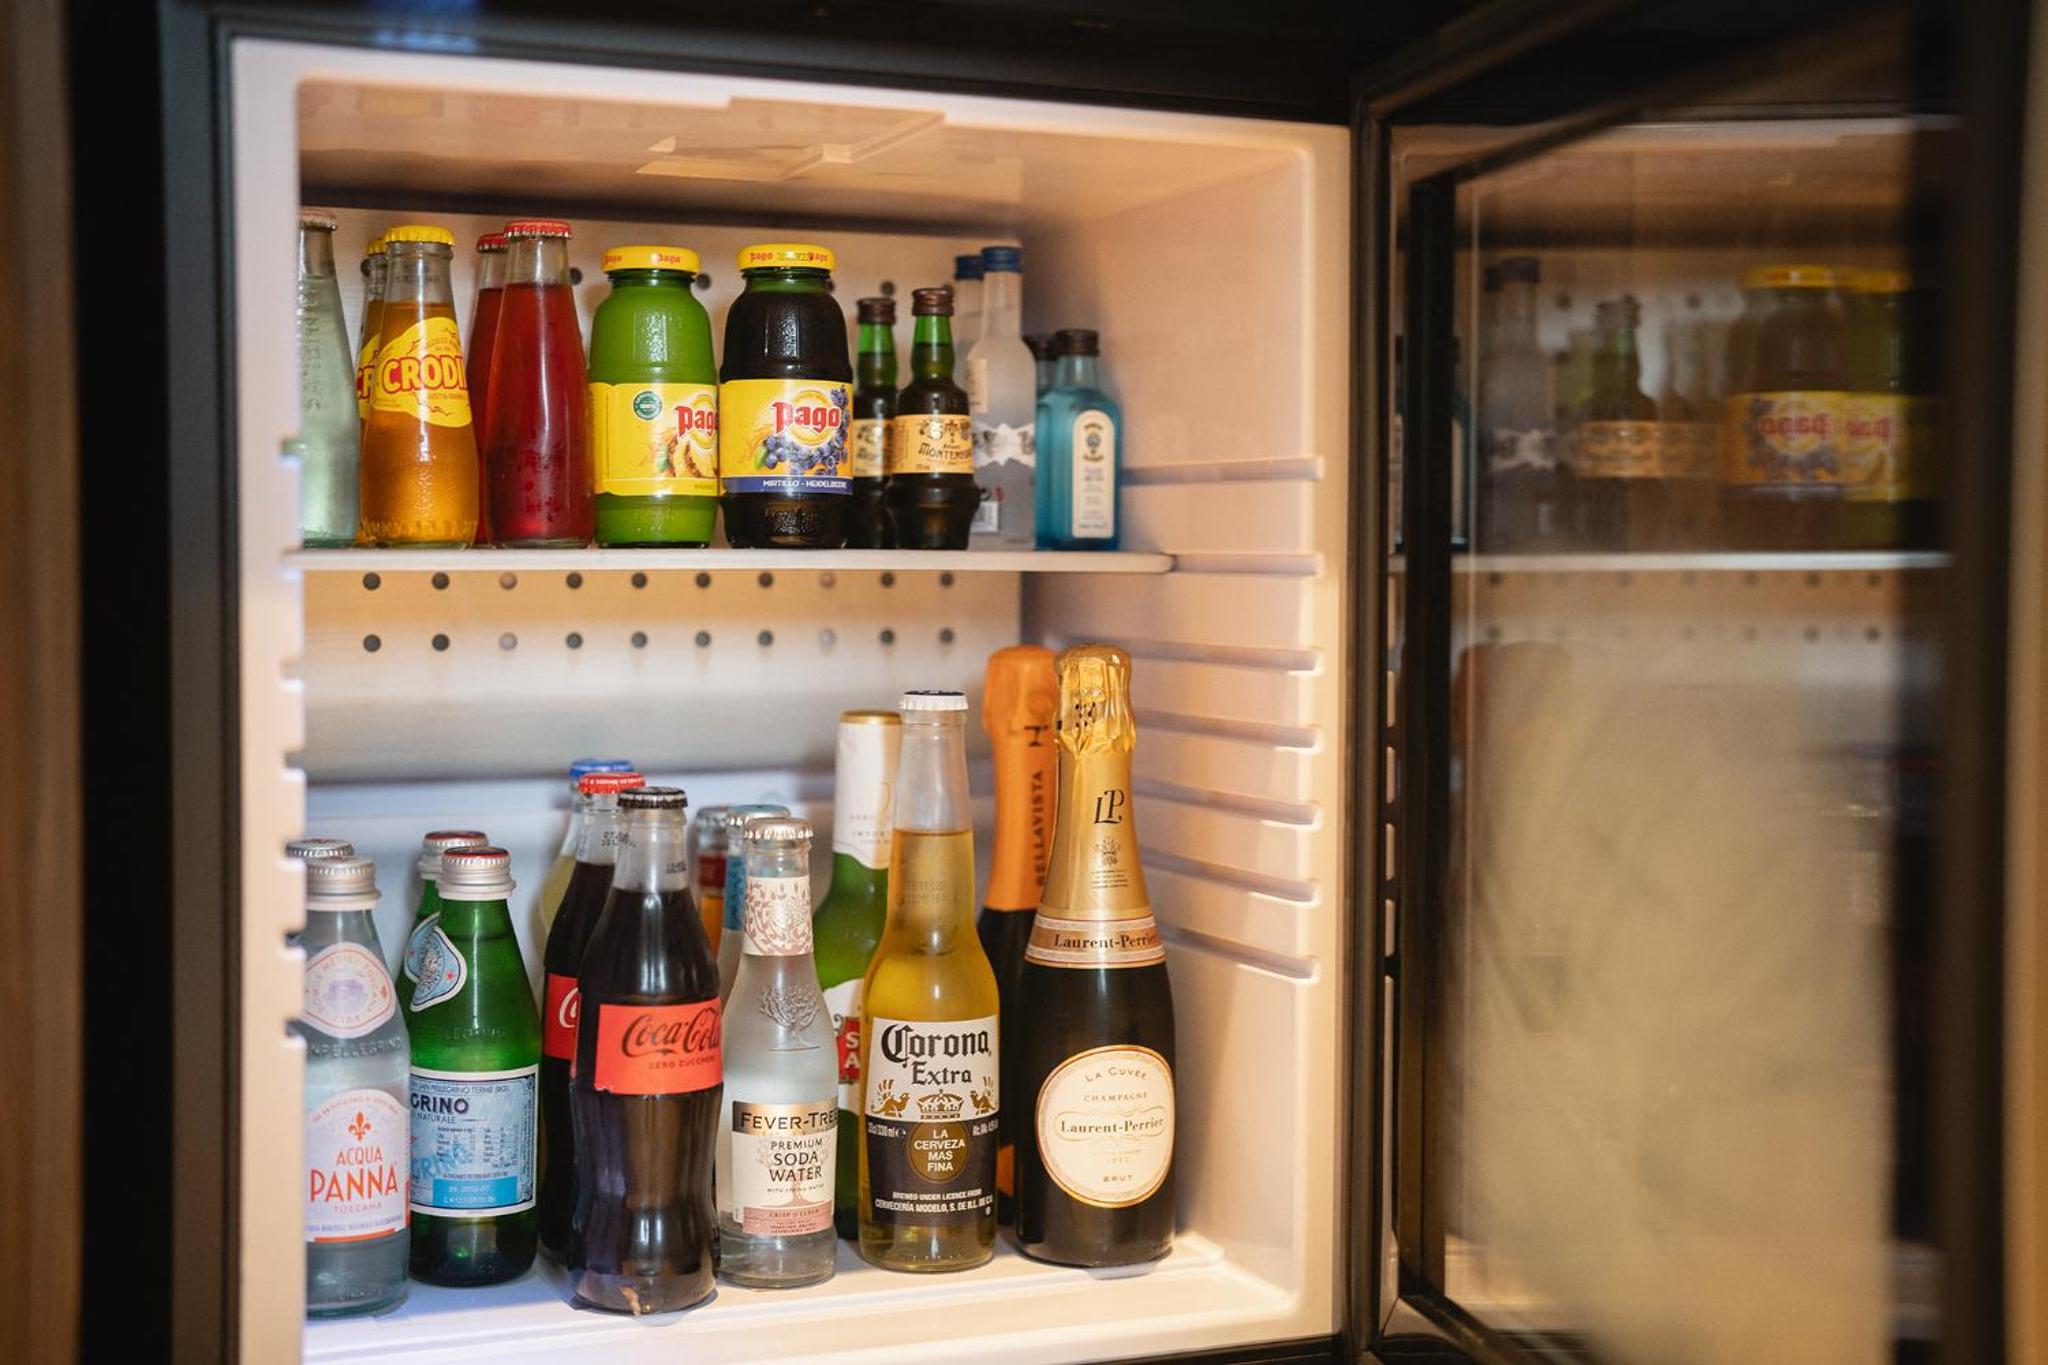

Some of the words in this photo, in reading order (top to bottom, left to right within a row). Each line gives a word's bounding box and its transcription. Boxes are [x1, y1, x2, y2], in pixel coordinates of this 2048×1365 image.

[881, 1023, 990, 1068] Corona
[911, 1060, 972, 1085] Extra
[1084, 1092, 1148, 1103] CHAMPAGNE
[417, 1112, 457, 1124] NATURALE
[1061, 1117, 1164, 1134] Laurent-Perrier
[933, 1130, 949, 1139] LA
[770, 1138, 823, 1150] PREMIUM
[914, 1139, 966, 1150] CERVEZA
[336, 1146, 383, 1166] ACQUA
[773, 1151, 819, 1167] SODA
[927, 1151, 954, 1161] MAS
[768, 1165, 822, 1183] WATER
[927, 1162, 954, 1172] FINA
[310, 1163, 399, 1203] PANNA
